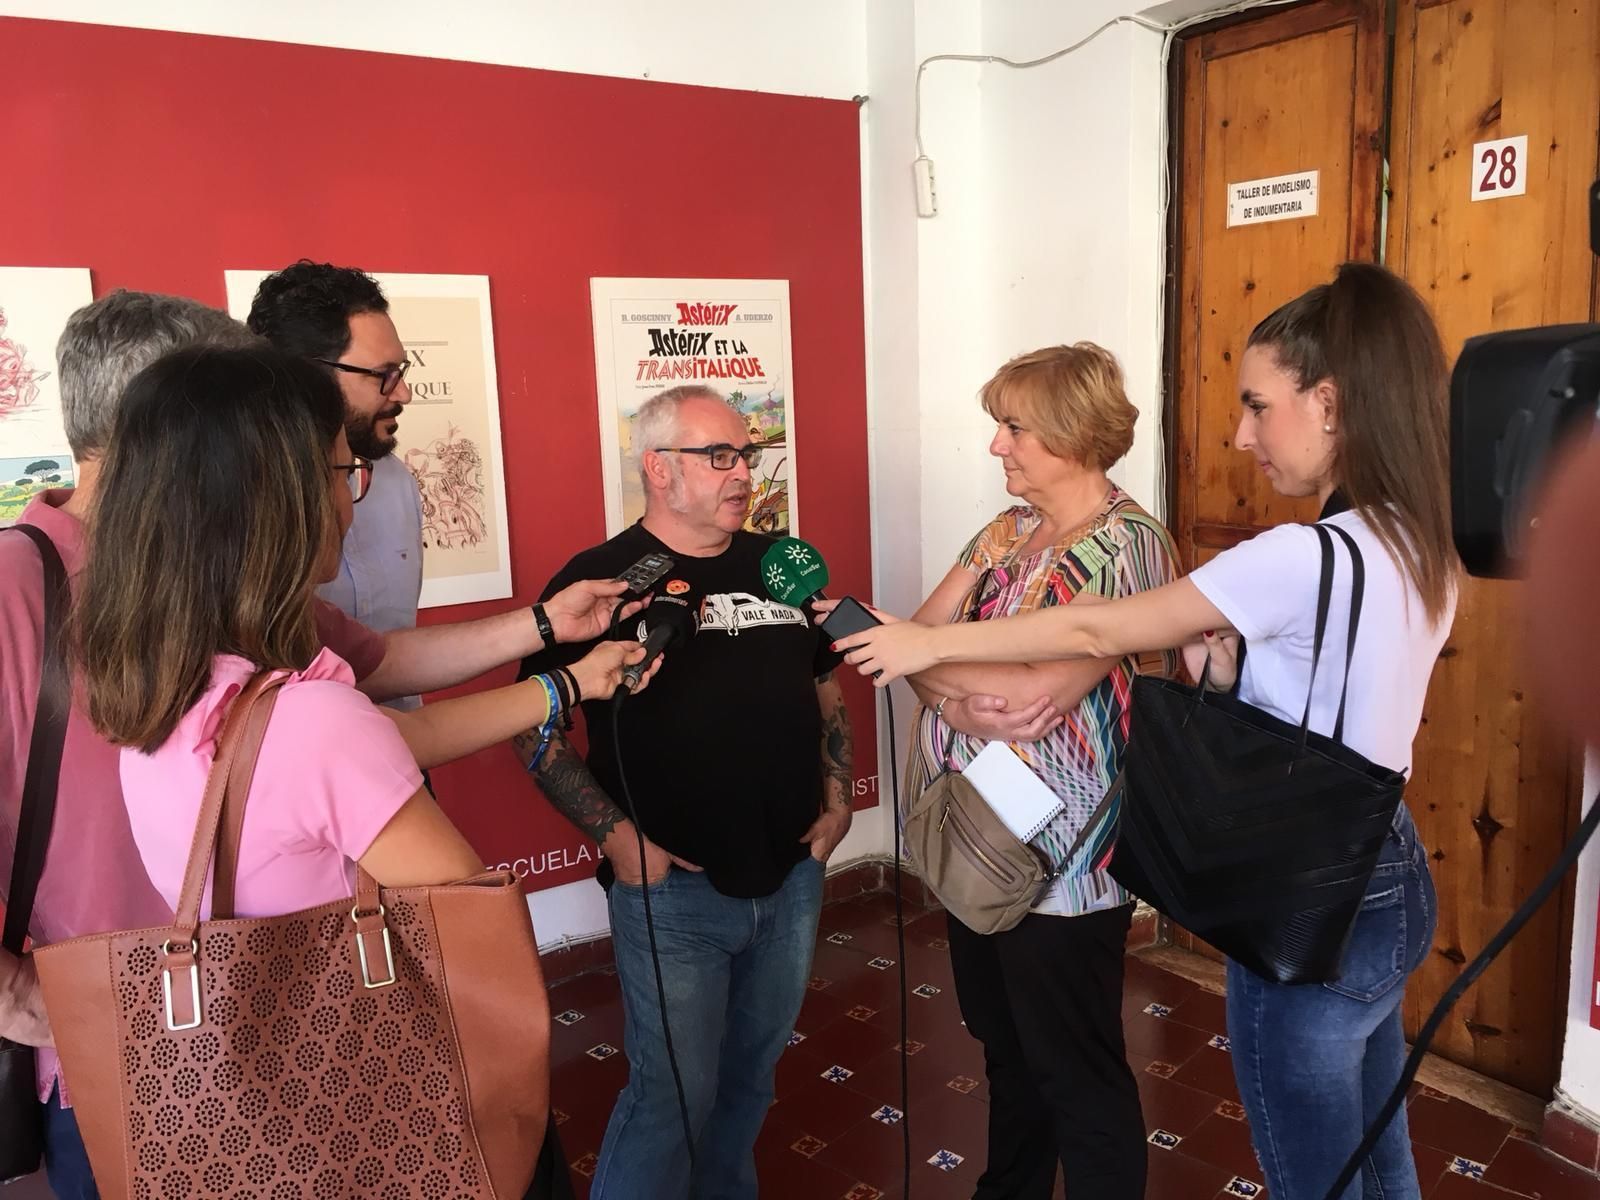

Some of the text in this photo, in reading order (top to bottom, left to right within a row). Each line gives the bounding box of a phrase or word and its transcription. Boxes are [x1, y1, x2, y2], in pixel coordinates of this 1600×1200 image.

[1479, 145, 1517, 192] 28
[1237, 179, 1311, 200] TALLER DE MODELISMO
[1244, 200, 1303, 218] DE INDUMENTARIA
[631, 314, 672, 322] GOSCINNY
[715, 340, 728, 355] ET
[732, 340, 749, 355] LA
[741, 610, 767, 621] VALE
[770, 609, 796, 620] NADA
[486, 844, 592, 879] CUELA
